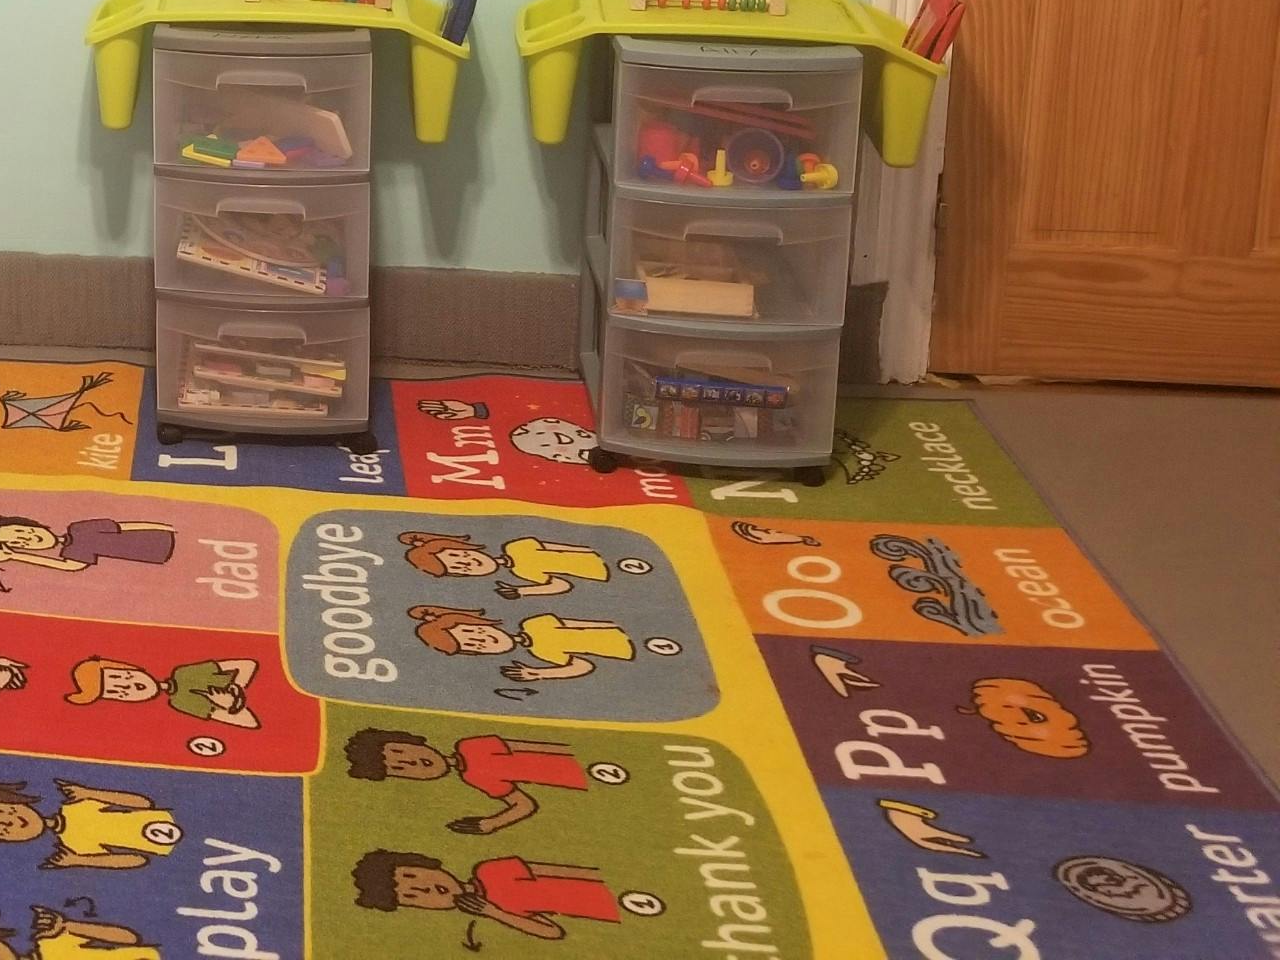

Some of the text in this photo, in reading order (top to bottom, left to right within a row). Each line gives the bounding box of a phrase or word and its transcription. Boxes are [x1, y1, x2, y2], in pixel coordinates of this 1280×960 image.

[77, 433, 124, 471] kite
[431, 425, 506, 490] Mm
[909, 421, 998, 511] necklace
[196, 539, 258, 600] dad
[302, 522, 398, 683] goodbye
[993, 548, 1085, 629] ocean
[835, 709, 946, 785] Pp
[1082, 663, 1219, 794] pumpkin
[664, 745, 754, 826] you
[176, 839, 282, 960] play
